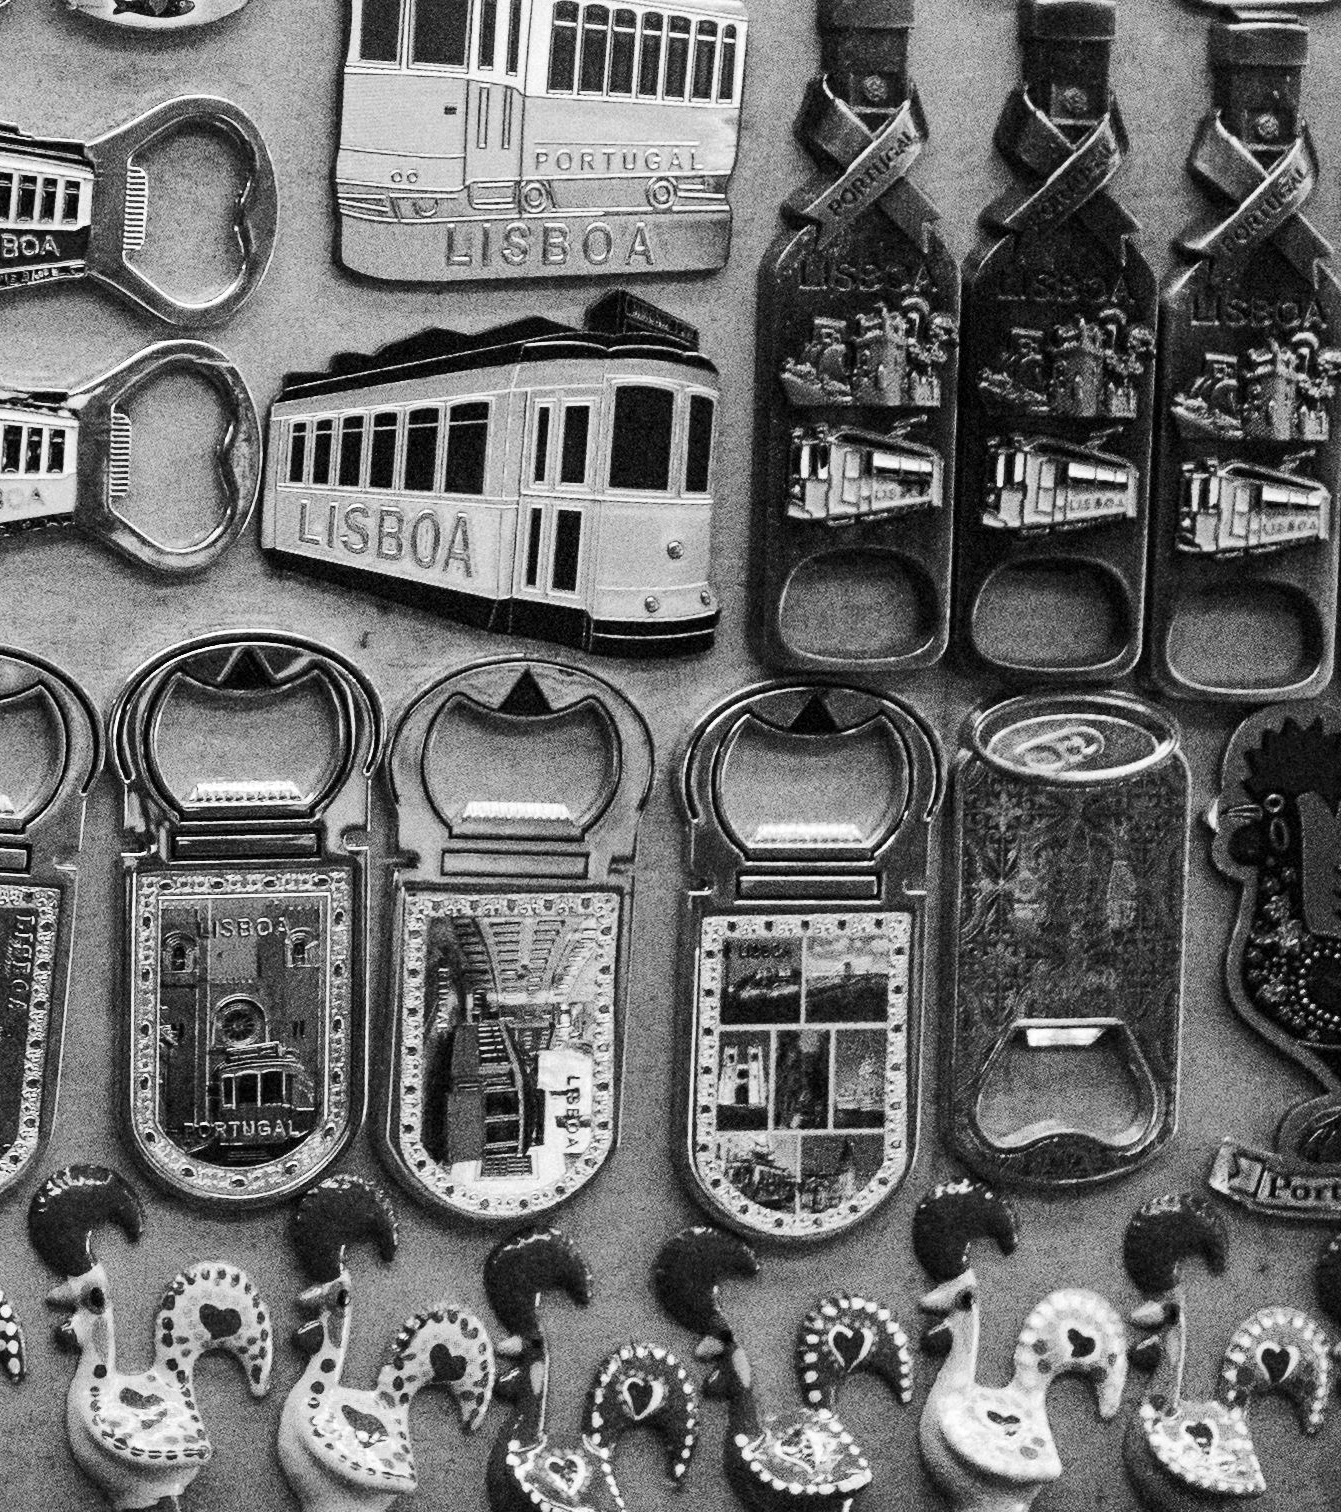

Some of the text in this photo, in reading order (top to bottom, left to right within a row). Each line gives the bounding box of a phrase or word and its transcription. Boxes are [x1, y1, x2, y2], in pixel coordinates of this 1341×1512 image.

[534, 149, 704, 172] PORTUGAL
[827, 129, 915, 218] PORTUGAL
[445, 221, 656, 267] LISBOA
[297, 498, 474, 579] LISBOA
[201, 917, 286, 939] LISBOA
[181, 1119, 300, 1139] PORTUGAL
[564, 1074, 582, 1156] LISBOA
